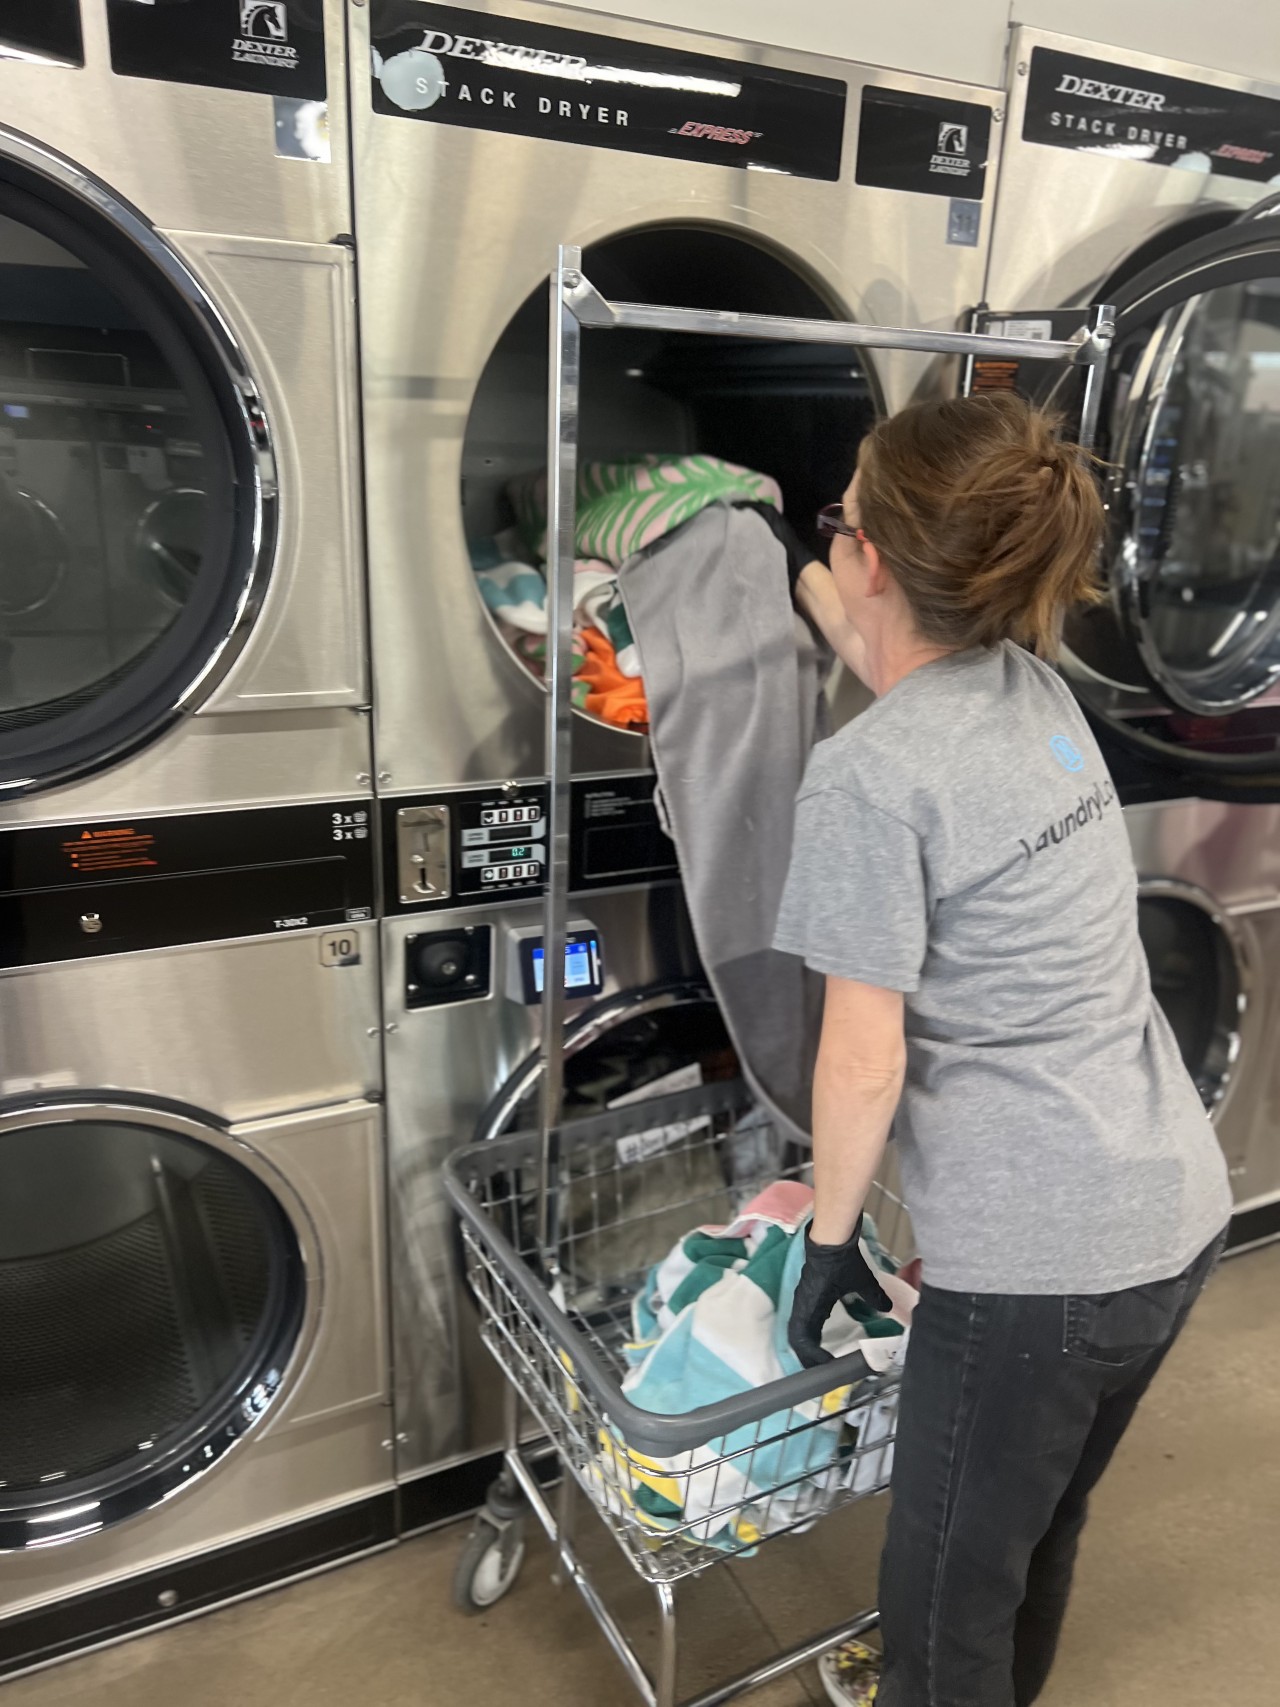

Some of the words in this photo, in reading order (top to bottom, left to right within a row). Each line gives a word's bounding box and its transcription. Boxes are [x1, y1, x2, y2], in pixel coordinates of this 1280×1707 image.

[231, 39, 297, 58] DEXTER
[415, 77, 517, 109] STACK
[538, 97, 629, 127] DRYER
[1055, 74, 1166, 112] DEXTER
[677, 121, 753, 145] EXPRESS
[1050, 112, 1117, 136] STACK
[1127, 126, 1188, 149] DRYER
[328, 939, 351, 956] 10
